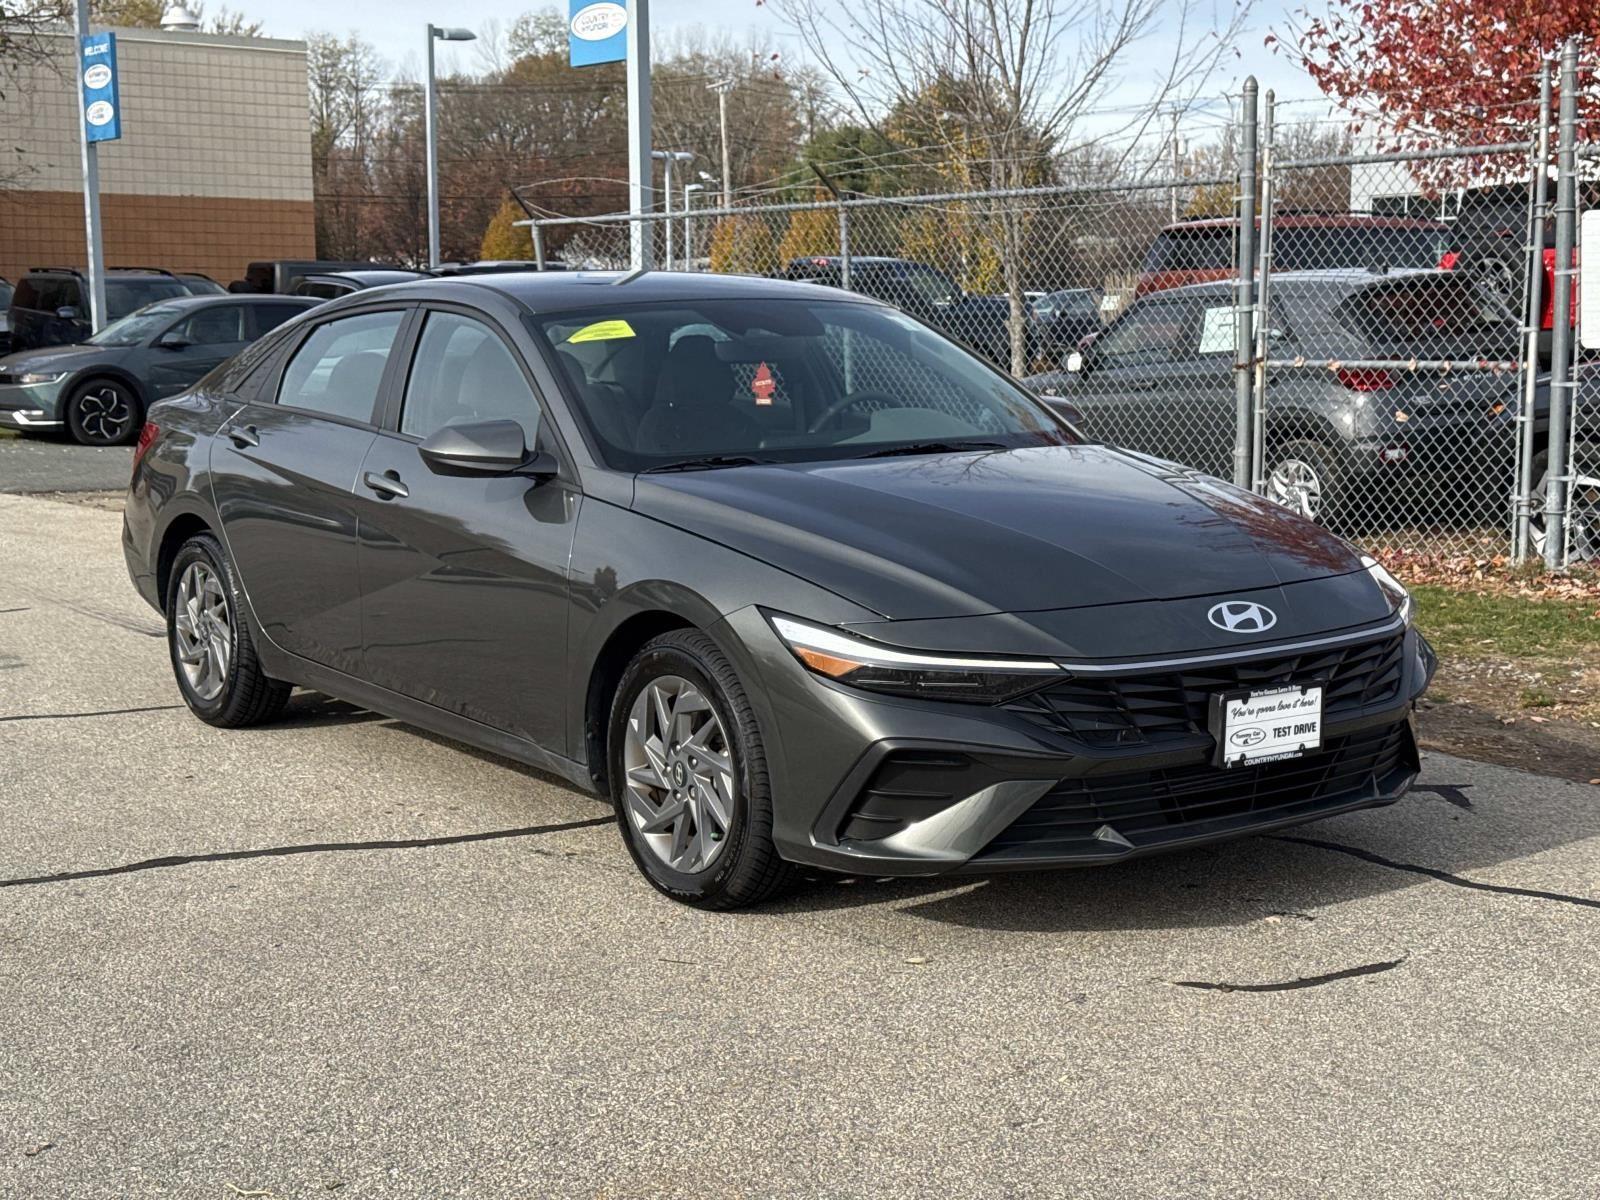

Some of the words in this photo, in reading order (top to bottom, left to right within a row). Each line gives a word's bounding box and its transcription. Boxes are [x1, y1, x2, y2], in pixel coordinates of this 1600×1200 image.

[84, 42, 109, 56] WELCOME
[1231, 707, 1255, 720] You're
[1255, 705, 1276, 719] gonna
[1277, 700, 1291, 711] love
[1292, 699, 1301, 709] it
[1299, 696, 1318, 708] here!
[1273, 725, 1292, 739] TEST
[1293, 721, 1317, 736] DRIVE
